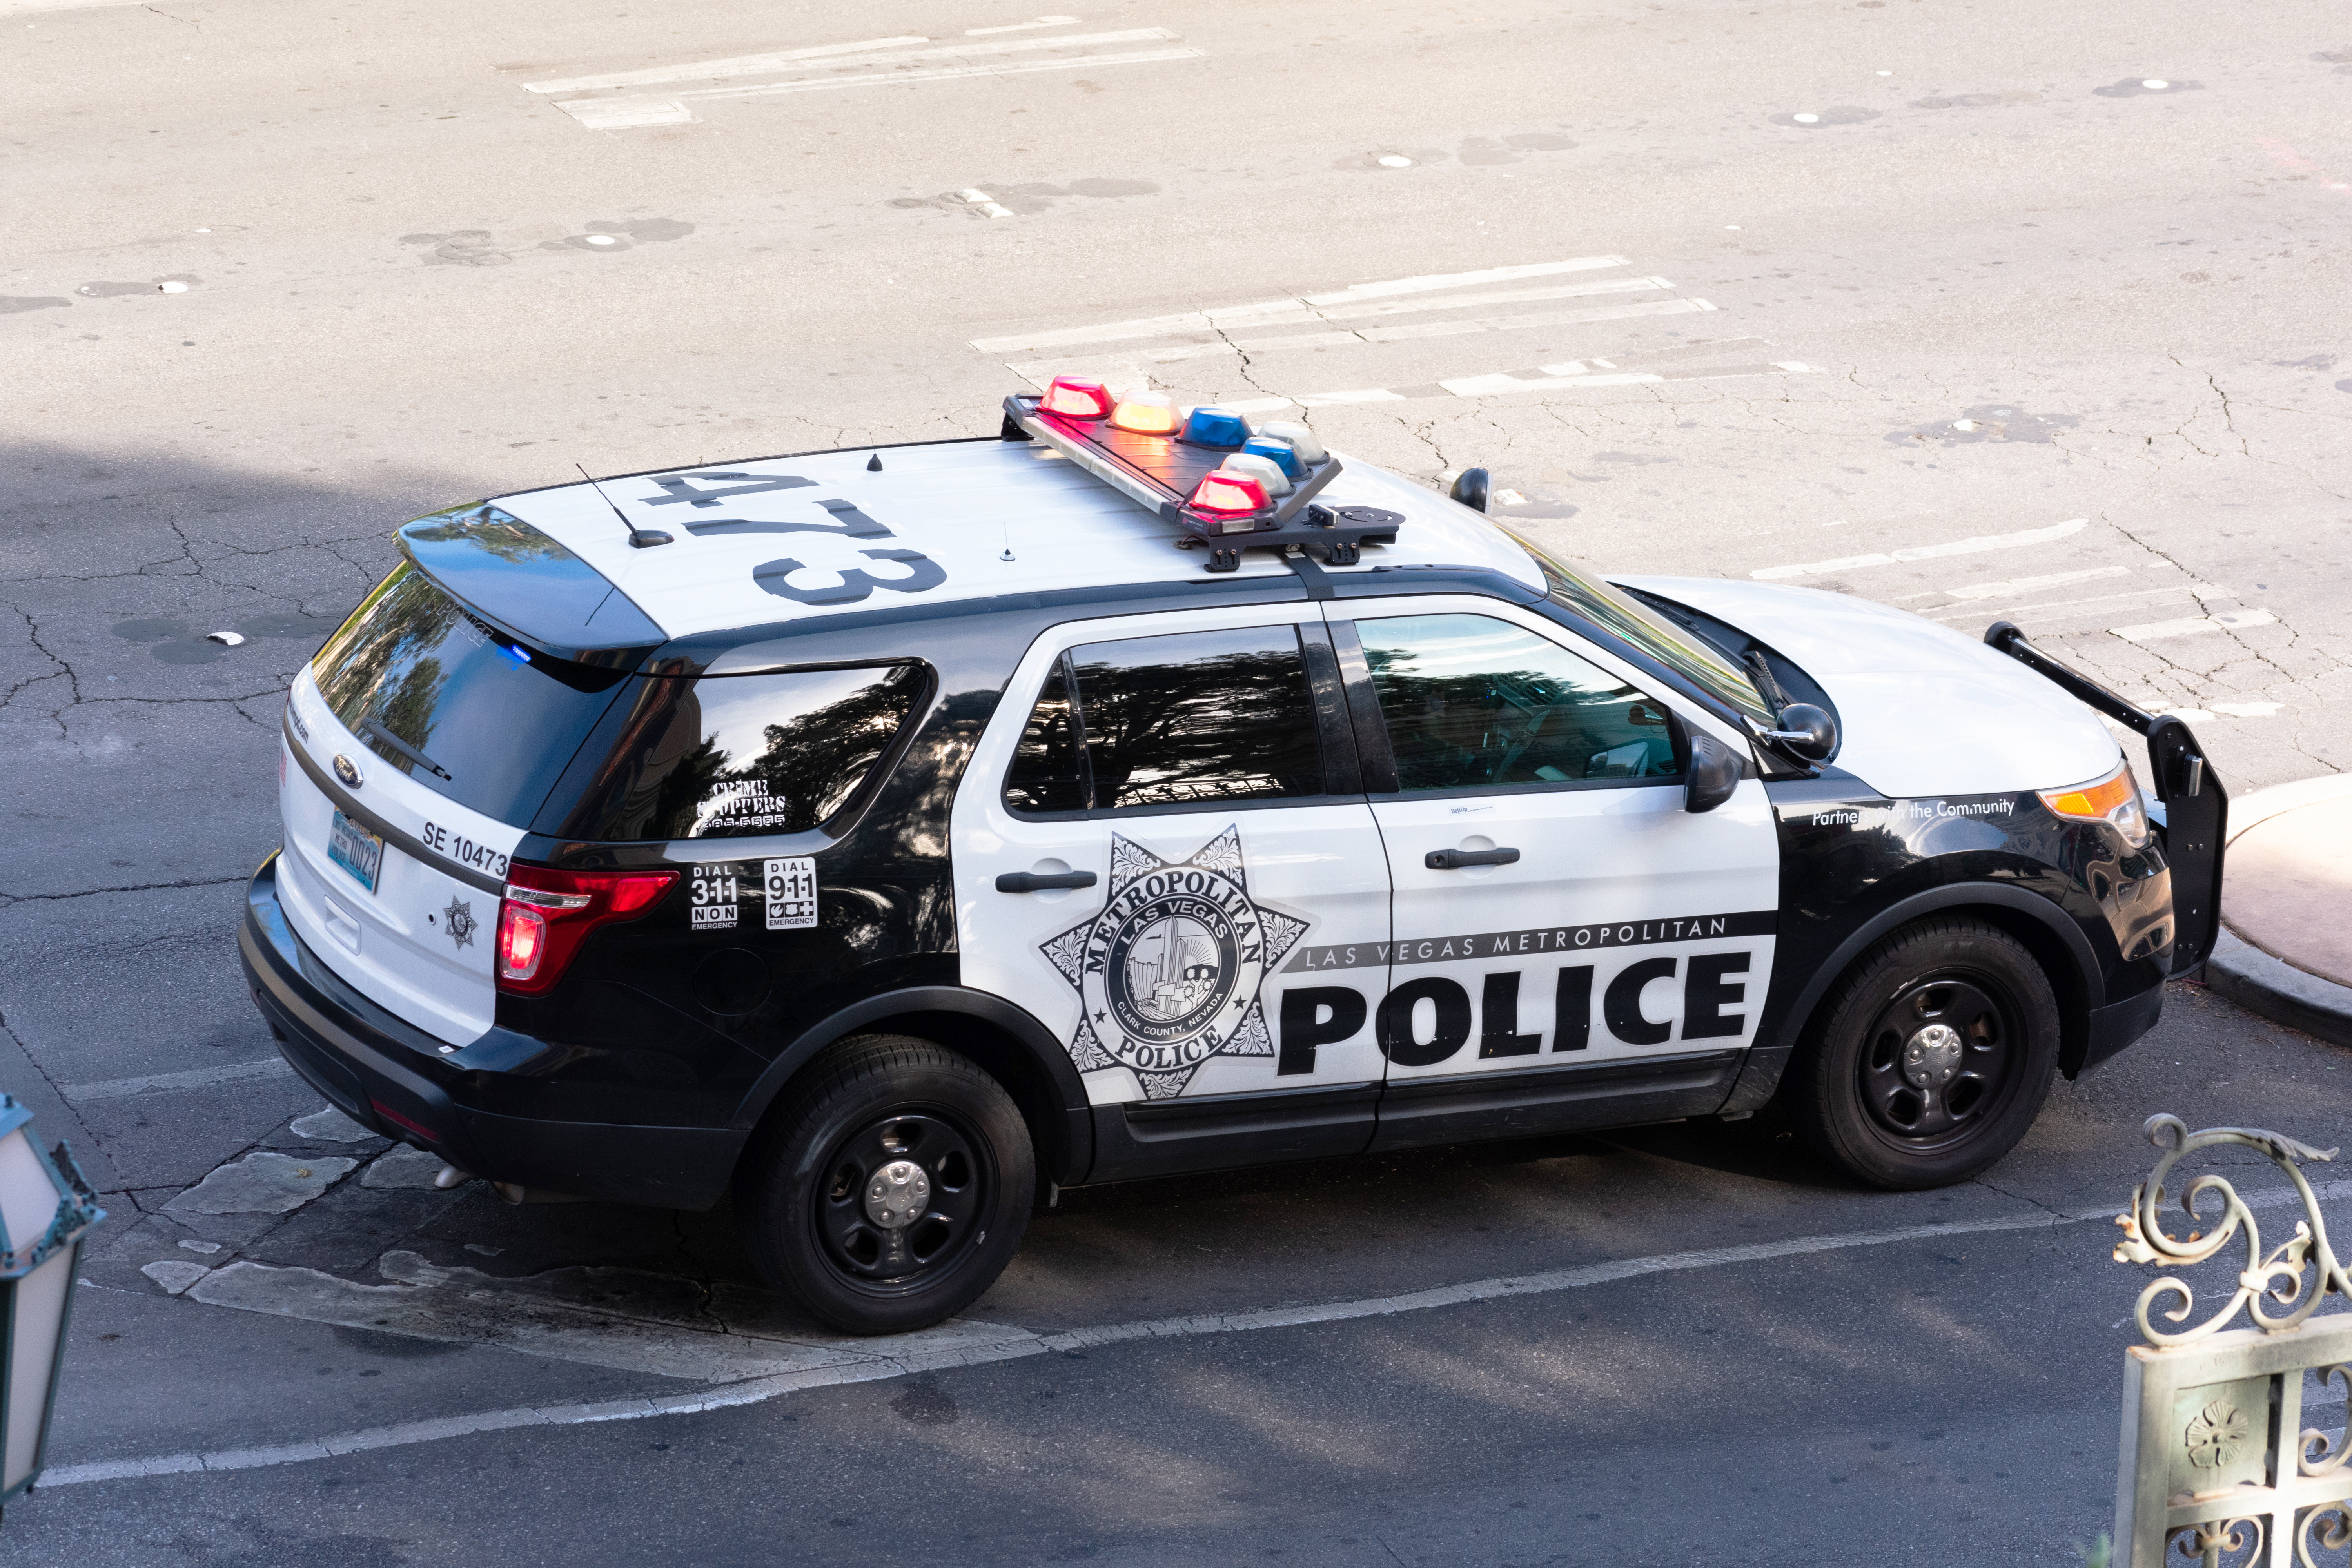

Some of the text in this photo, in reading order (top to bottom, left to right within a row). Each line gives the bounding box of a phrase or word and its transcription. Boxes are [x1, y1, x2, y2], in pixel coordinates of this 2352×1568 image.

[638, 472, 947, 606] 473
[436, 599, 494, 647] POLICE
[1813, 799, 2014, 826] Partners with the Community
[334, 833, 347, 849] METRO
[342, 825, 353, 841] VEGAS
[423, 822, 508, 876] SE 10473
[332, 845, 347, 862] POLICE
[771, 862, 808, 873] DIAL
[693, 866, 732, 877] DIAL
[692, 922, 737, 930] EMERGENCY
[695, 907, 735, 921] NON
[769, 918, 814, 926] EMERGENCY
[1085, 871, 1261, 976] METROPOLITAN
[1120, 901, 1227, 945] LAS VEGAS
[1306, 918, 1725, 967] LAS VEGAS METROPOLITAN
[1118, 993, 1223, 1036] CLARK COUNTY, NEVADA
[1277, 951, 1751, 1076] POLICE
[1115, 1025, 1223, 1069] POLICE
